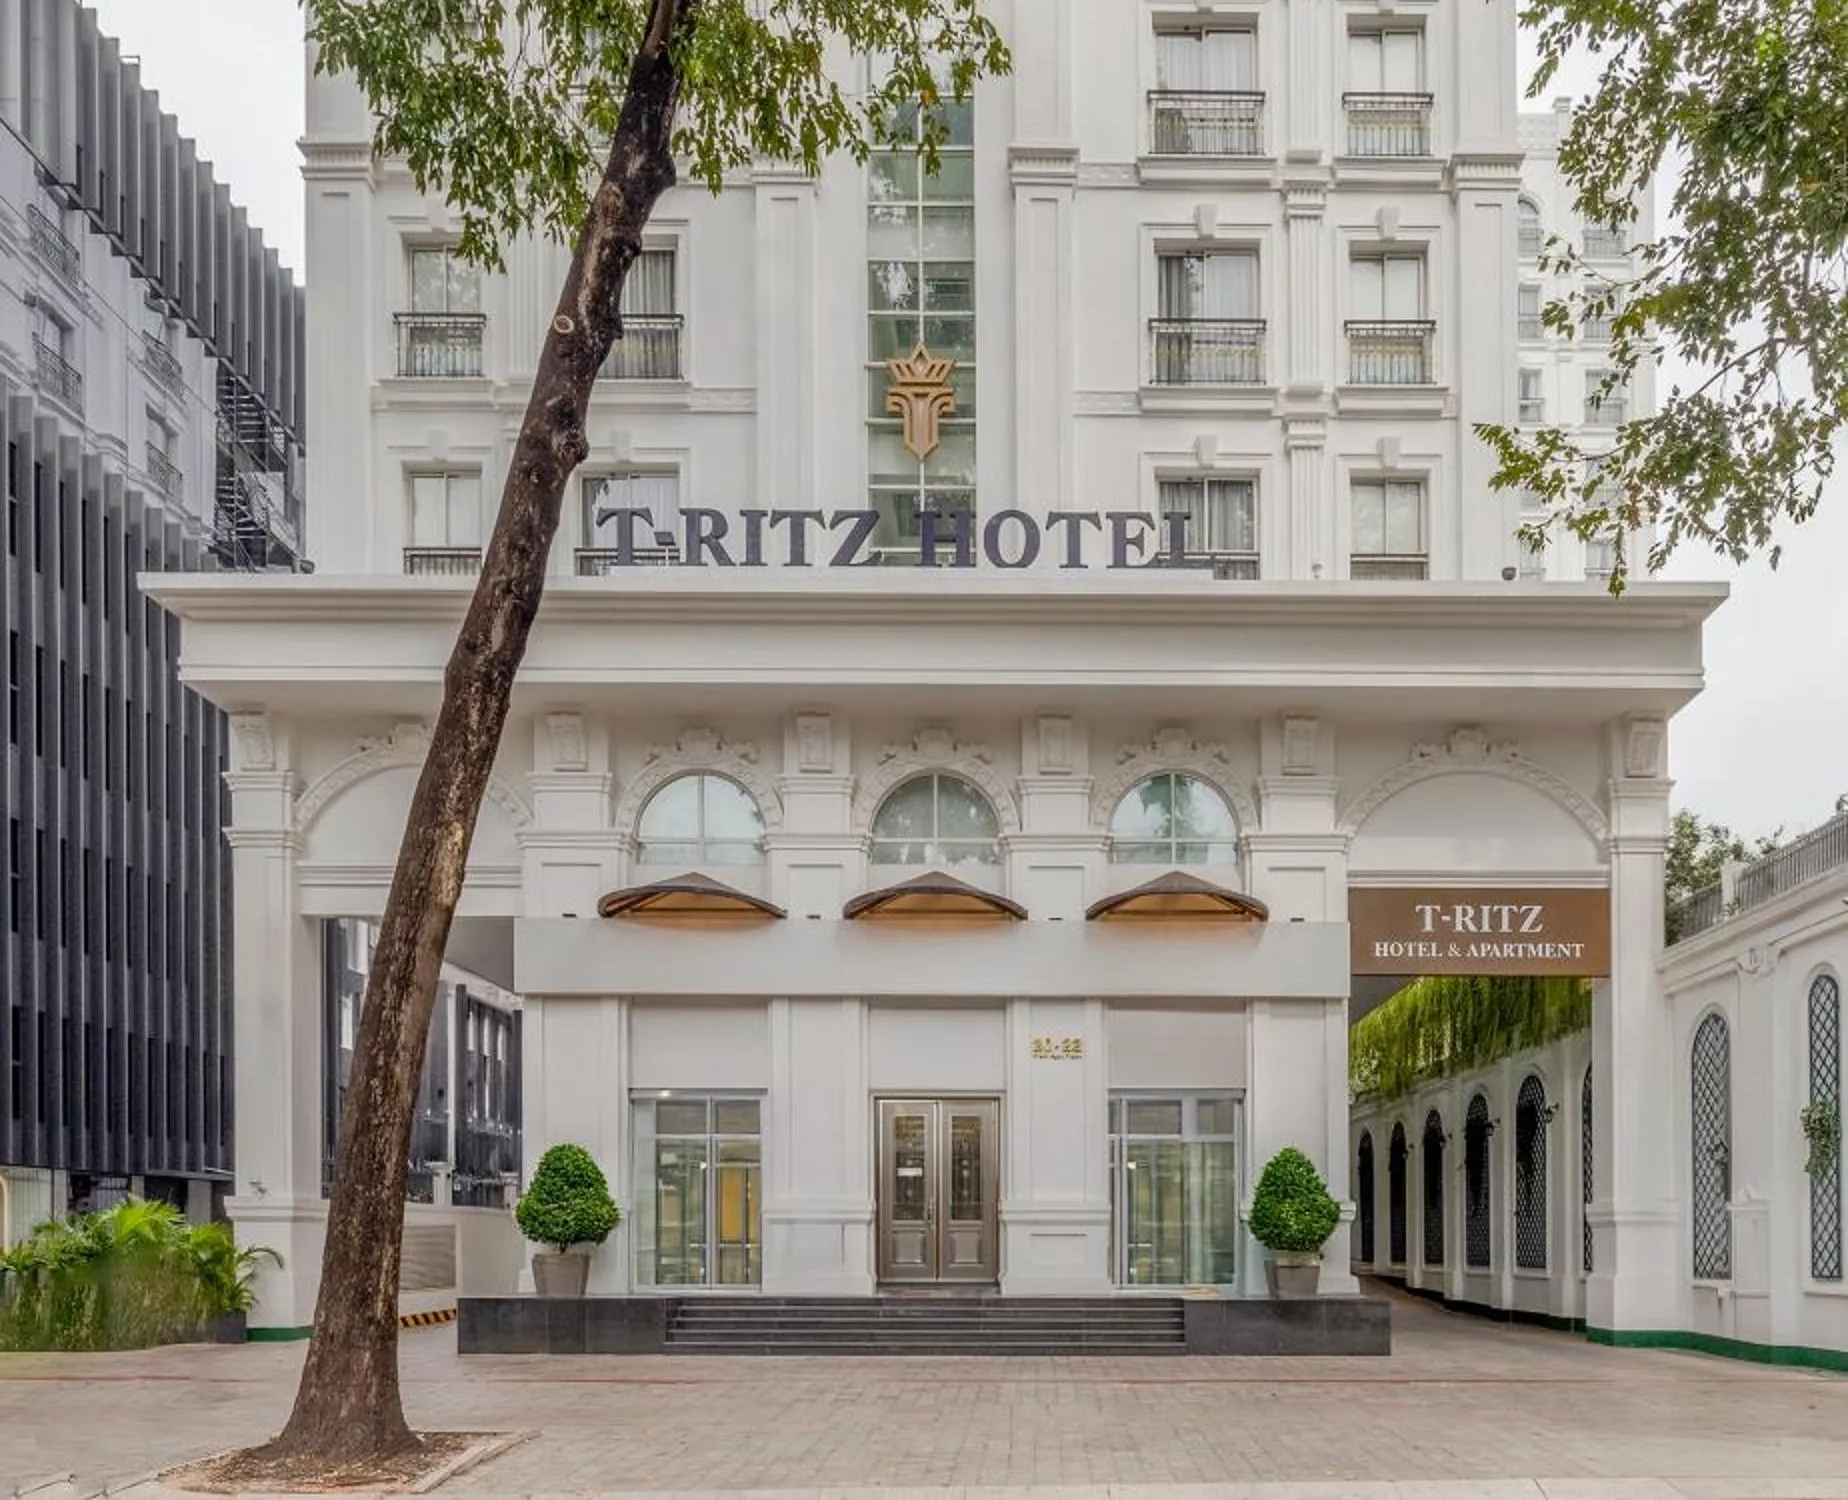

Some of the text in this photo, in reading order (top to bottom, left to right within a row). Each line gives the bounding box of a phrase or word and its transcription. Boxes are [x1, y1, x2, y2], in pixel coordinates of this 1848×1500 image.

[596, 507, 1214, 569] T-RITZ HOTEL
[1415, 904, 1544, 934] T-RITZ
[1374, 941, 1585, 959] HOTEL & APARTMENT
